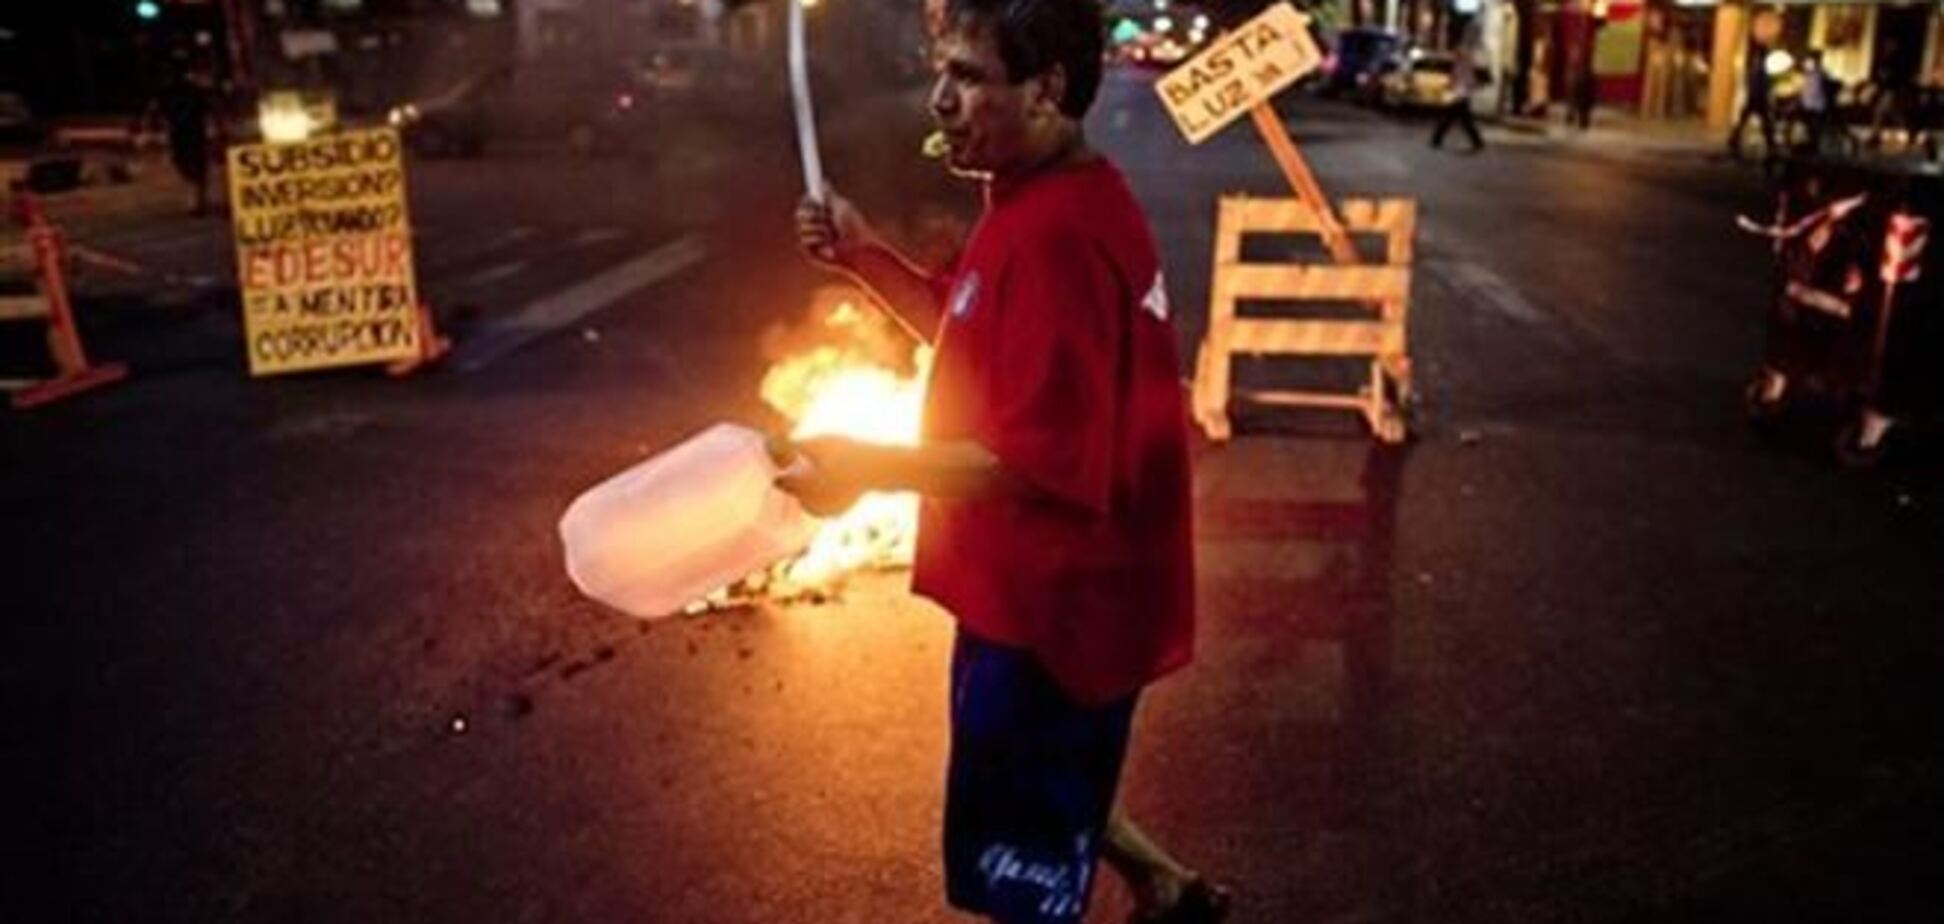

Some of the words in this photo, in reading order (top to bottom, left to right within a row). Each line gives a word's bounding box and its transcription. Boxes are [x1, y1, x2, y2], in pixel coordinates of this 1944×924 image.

[1164, 22, 1281, 106] BASTA
[1179, 78, 1250, 133] LUZ
[239, 133, 394, 177] SUBSIDIO
[245, 230, 406, 290] EDESUR
